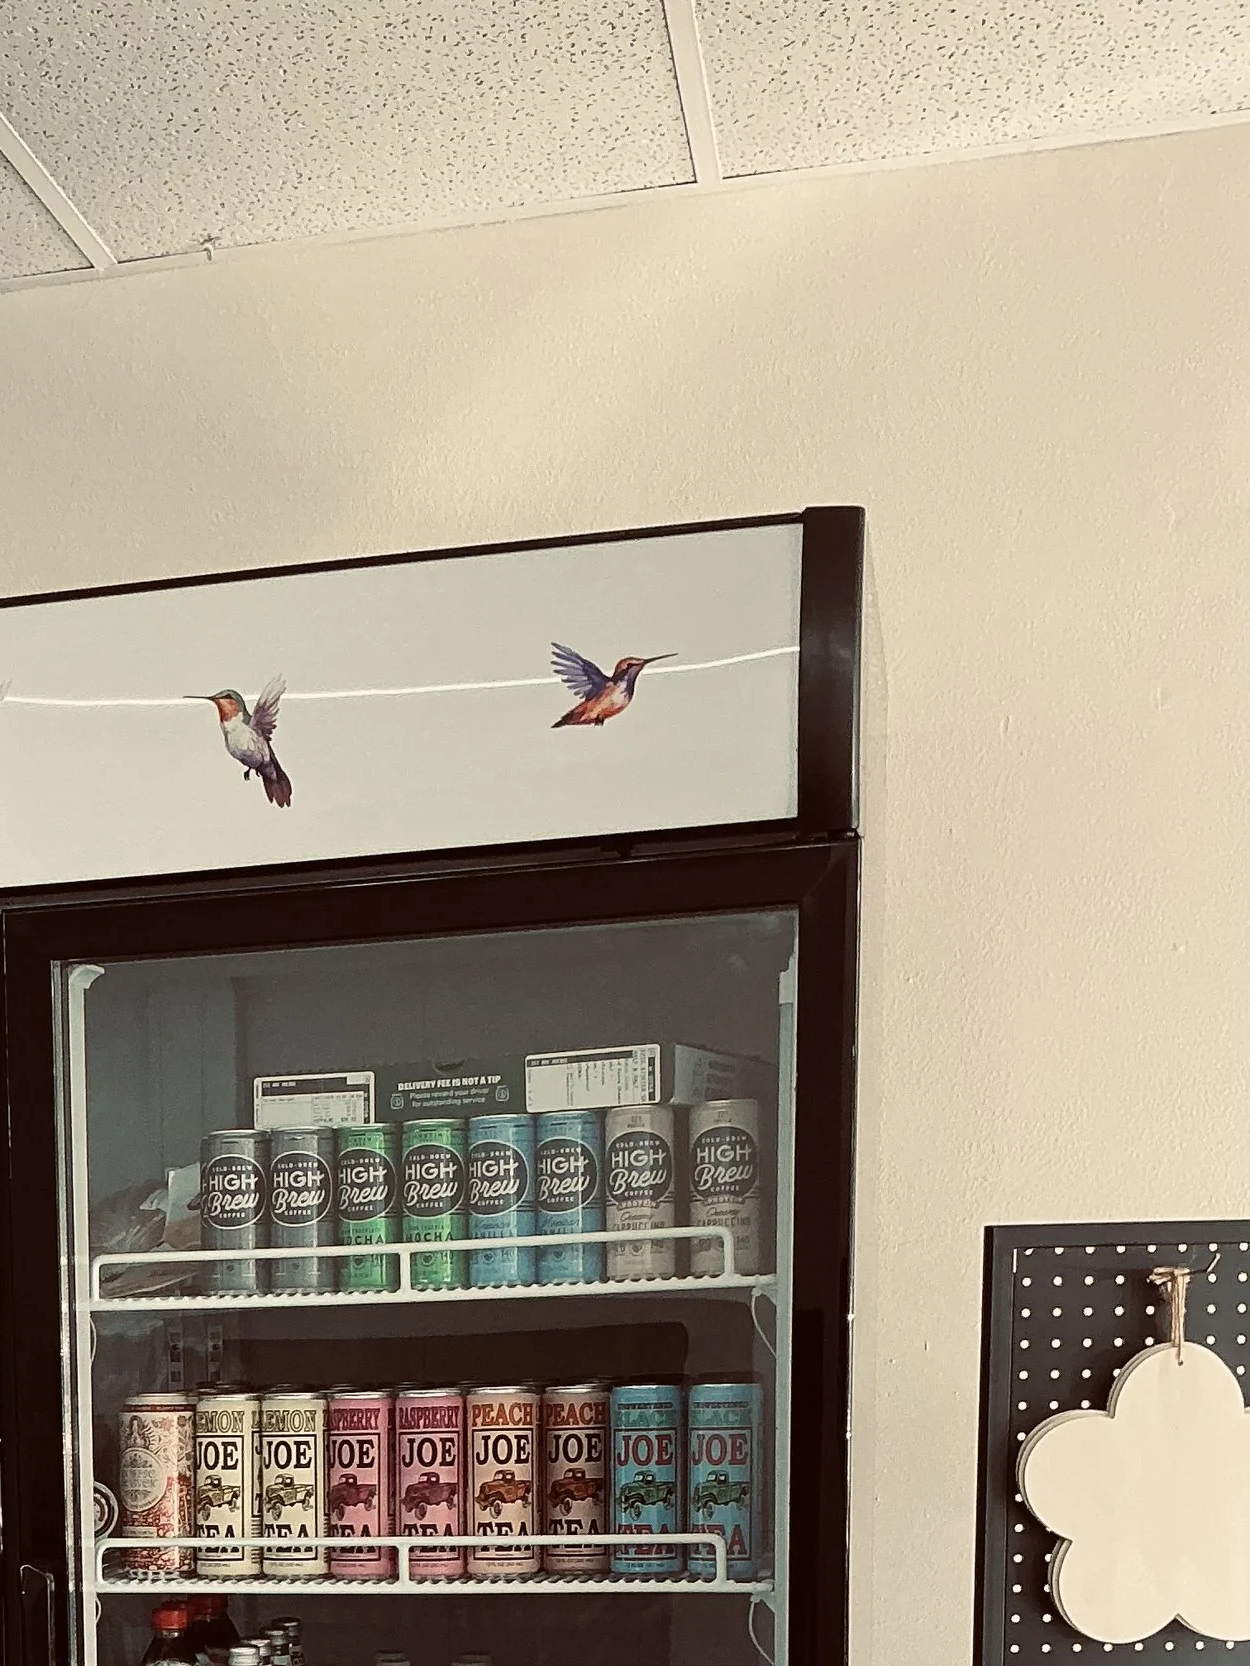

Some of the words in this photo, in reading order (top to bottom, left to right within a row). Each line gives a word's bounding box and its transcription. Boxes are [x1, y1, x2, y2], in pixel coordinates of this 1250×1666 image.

[397, 1080, 436, 1091] DELIVERY
[437, 1079, 451, 1088] FEE
[452, 1078, 461, 1087] IS
[461, 1077, 479, 1086] NOT
[479, 1076, 487, 1085] A
[487, 1075, 502, 1084] TIP
[405, 1161, 456, 1180] HIGH
[469, 1158, 519, 1178] HIGH
[539, 1156, 588, 1174] HIGH
[611, 1149, 667, 1170] HIGH
[209, 1171, 258, 1191] HIGH
[273, 1170, 325, 1189] HIGH
[339, 1165, 388, 1184] HIGH
[539, 1174, 590, 1200] Brew
[610, 1169, 667, 1195] Brew
[694, 1163, 753, 1192] Brew
[209, 1191, 260, 1214] Brew
[272, 1189, 326, 1213] Brew
[339, 1184, 389, 1211] Brew
[404, 1181, 458, 1206] Brew
[470, 1178, 520, 1204] Brew
[261, 1409, 317, 1433] LEMON
[399, 1405, 460, 1430] RASPBERRY
[472, 1402, 534, 1428] PEACH
[546, 1401, 607, 1427] PEACH
[617, 1408, 678, 1428] BLACK
[263, 1439, 312, 1470] JOE
[402, 1436, 456, 1468] JOE
[476, 1433, 531, 1466] JOE
[549, 1432, 602, 1465] JOE
[617, 1433, 674, 1467] JOE
[692, 1433, 749, 1467] JOE
[477, 1521, 532, 1552] TEA
[618, 1523, 676, 1555] TEA
